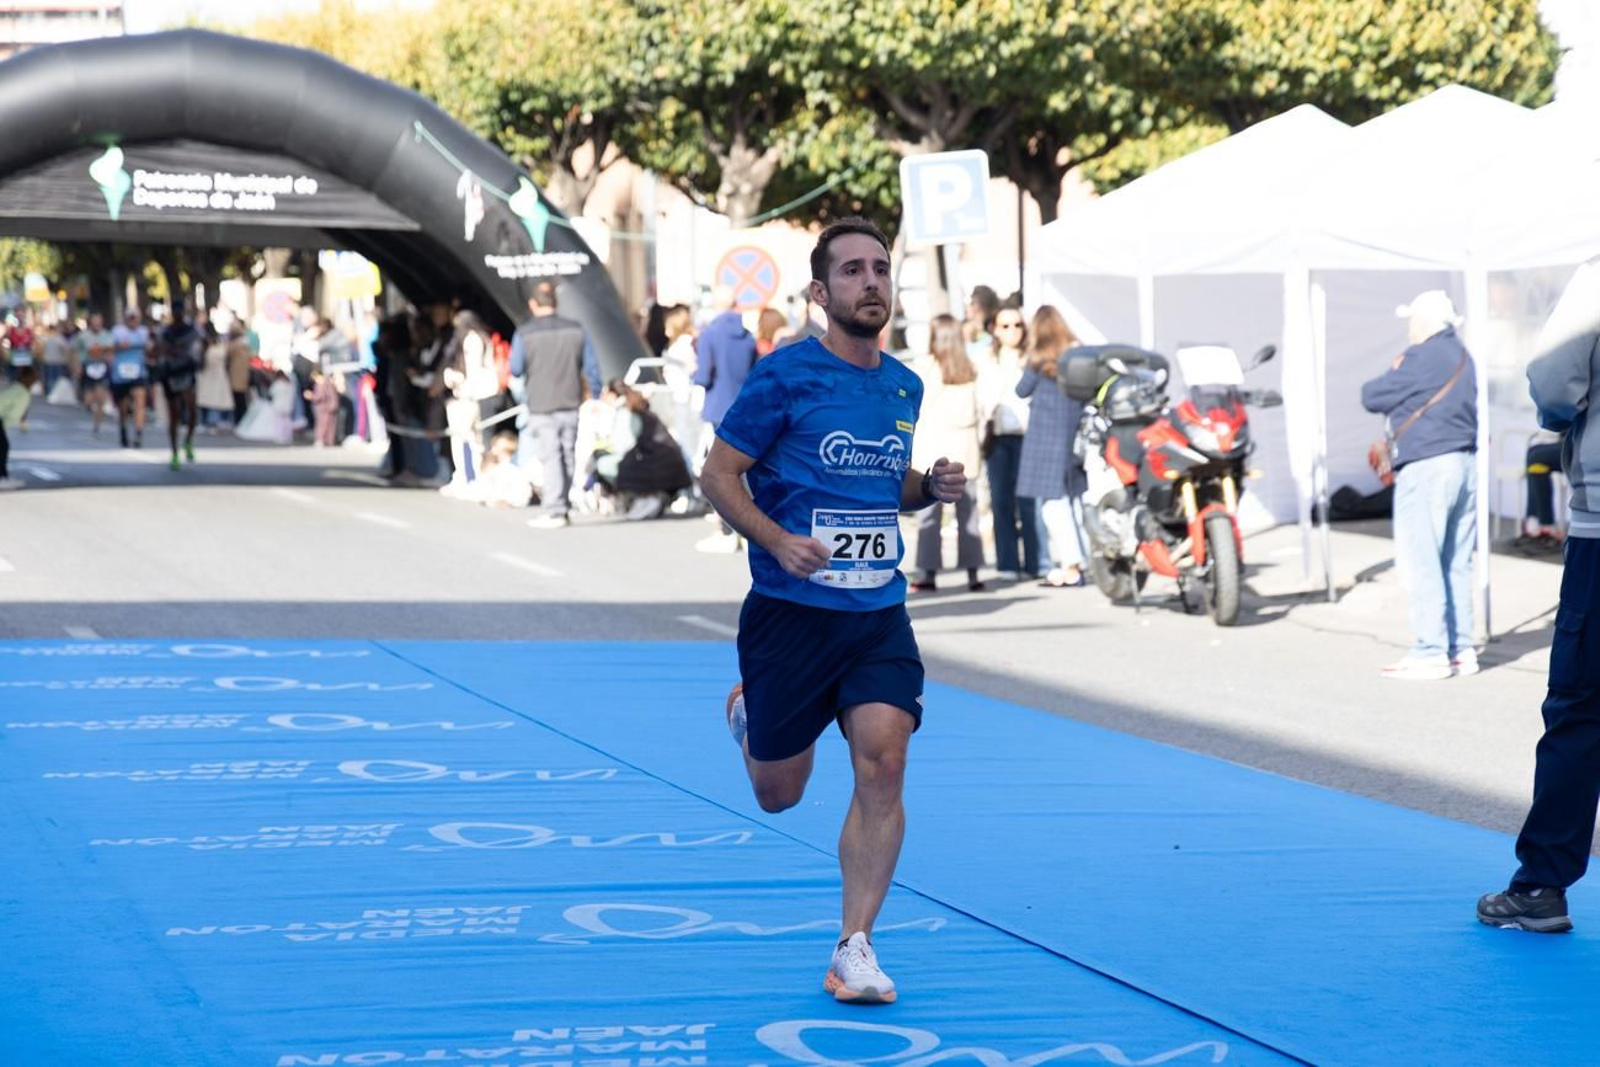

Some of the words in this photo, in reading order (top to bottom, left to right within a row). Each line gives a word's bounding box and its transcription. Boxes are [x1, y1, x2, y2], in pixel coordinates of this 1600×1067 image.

[920, 164, 973, 235] P
[832, 533, 886, 559] 276
[283, 927, 516, 942] MEDIA
[512, 1023, 716, 1042] JAÉN
[275, 1040, 706, 1067] MARATÓN
